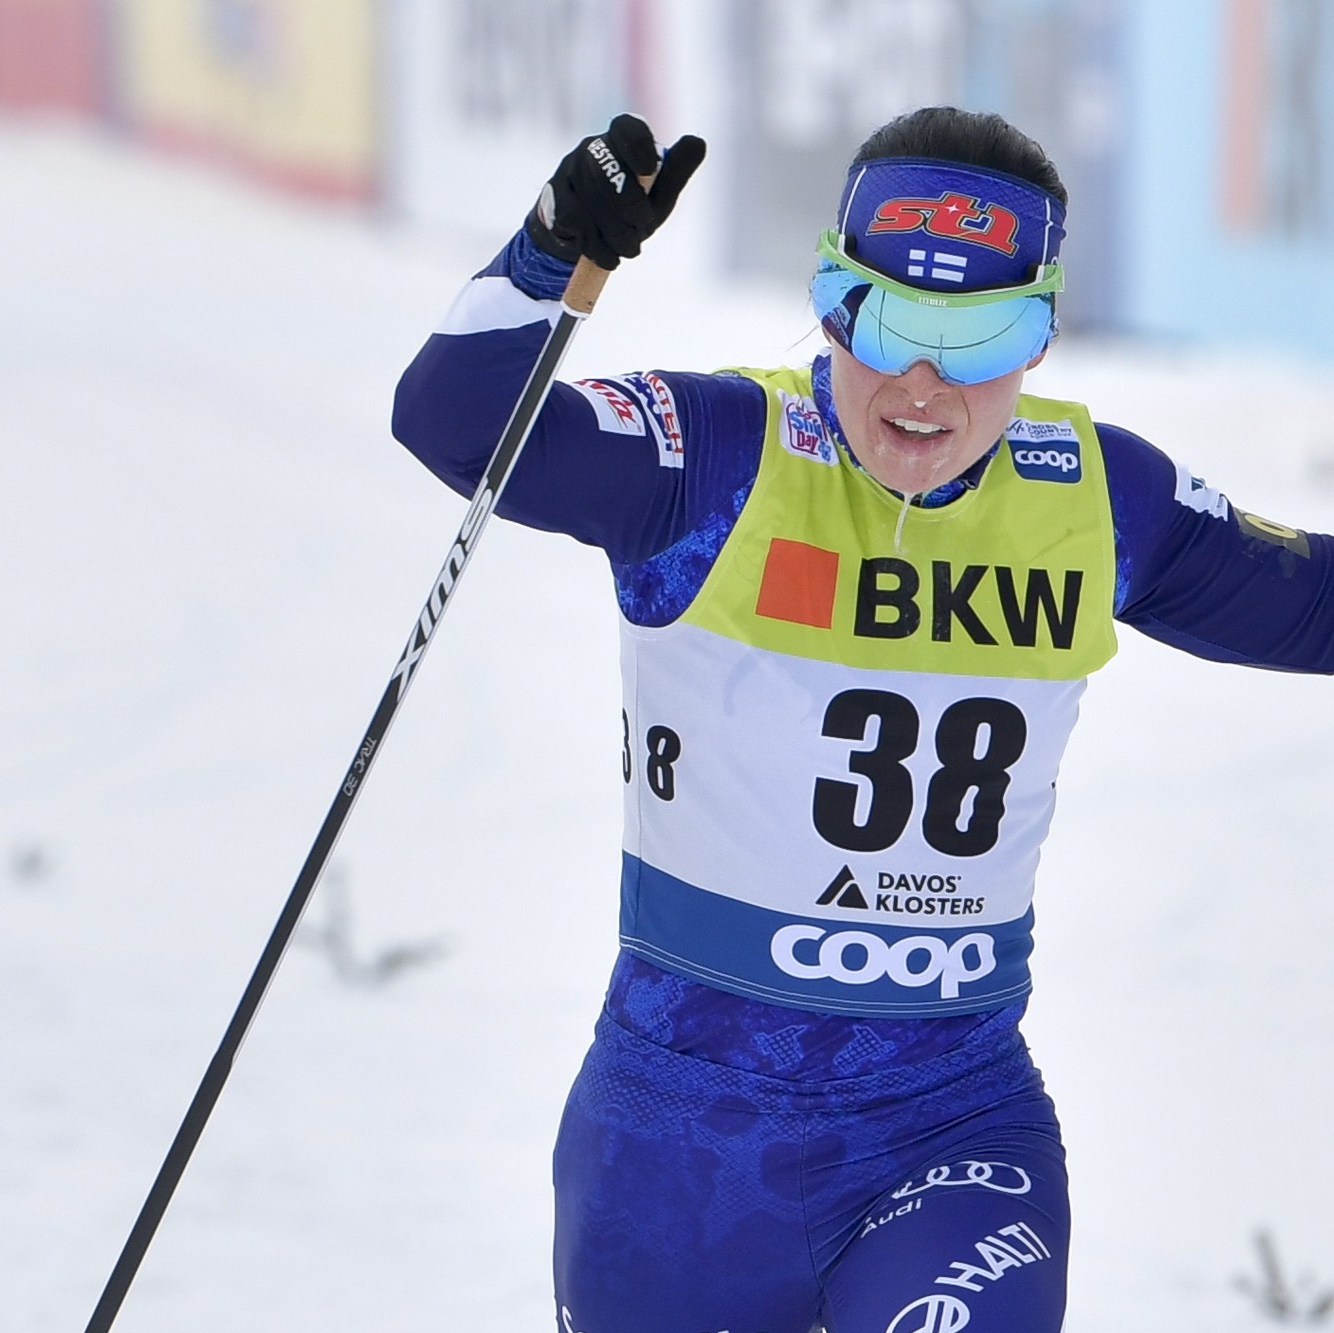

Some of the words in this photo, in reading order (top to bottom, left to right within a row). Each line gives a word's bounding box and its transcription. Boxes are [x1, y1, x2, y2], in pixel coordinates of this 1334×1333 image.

[1014, 450, 1079, 473] coop
[853, 556, 1084, 650] BKW
[812, 688, 1028, 857] 38
[875, 894, 985, 915] KLOSTERS
[877, 872, 957, 893] DAVOS
[770, 923, 997, 999] coop
[860, 1198, 923, 1239] Audi
[933, 1221, 1052, 1293] HALTI
